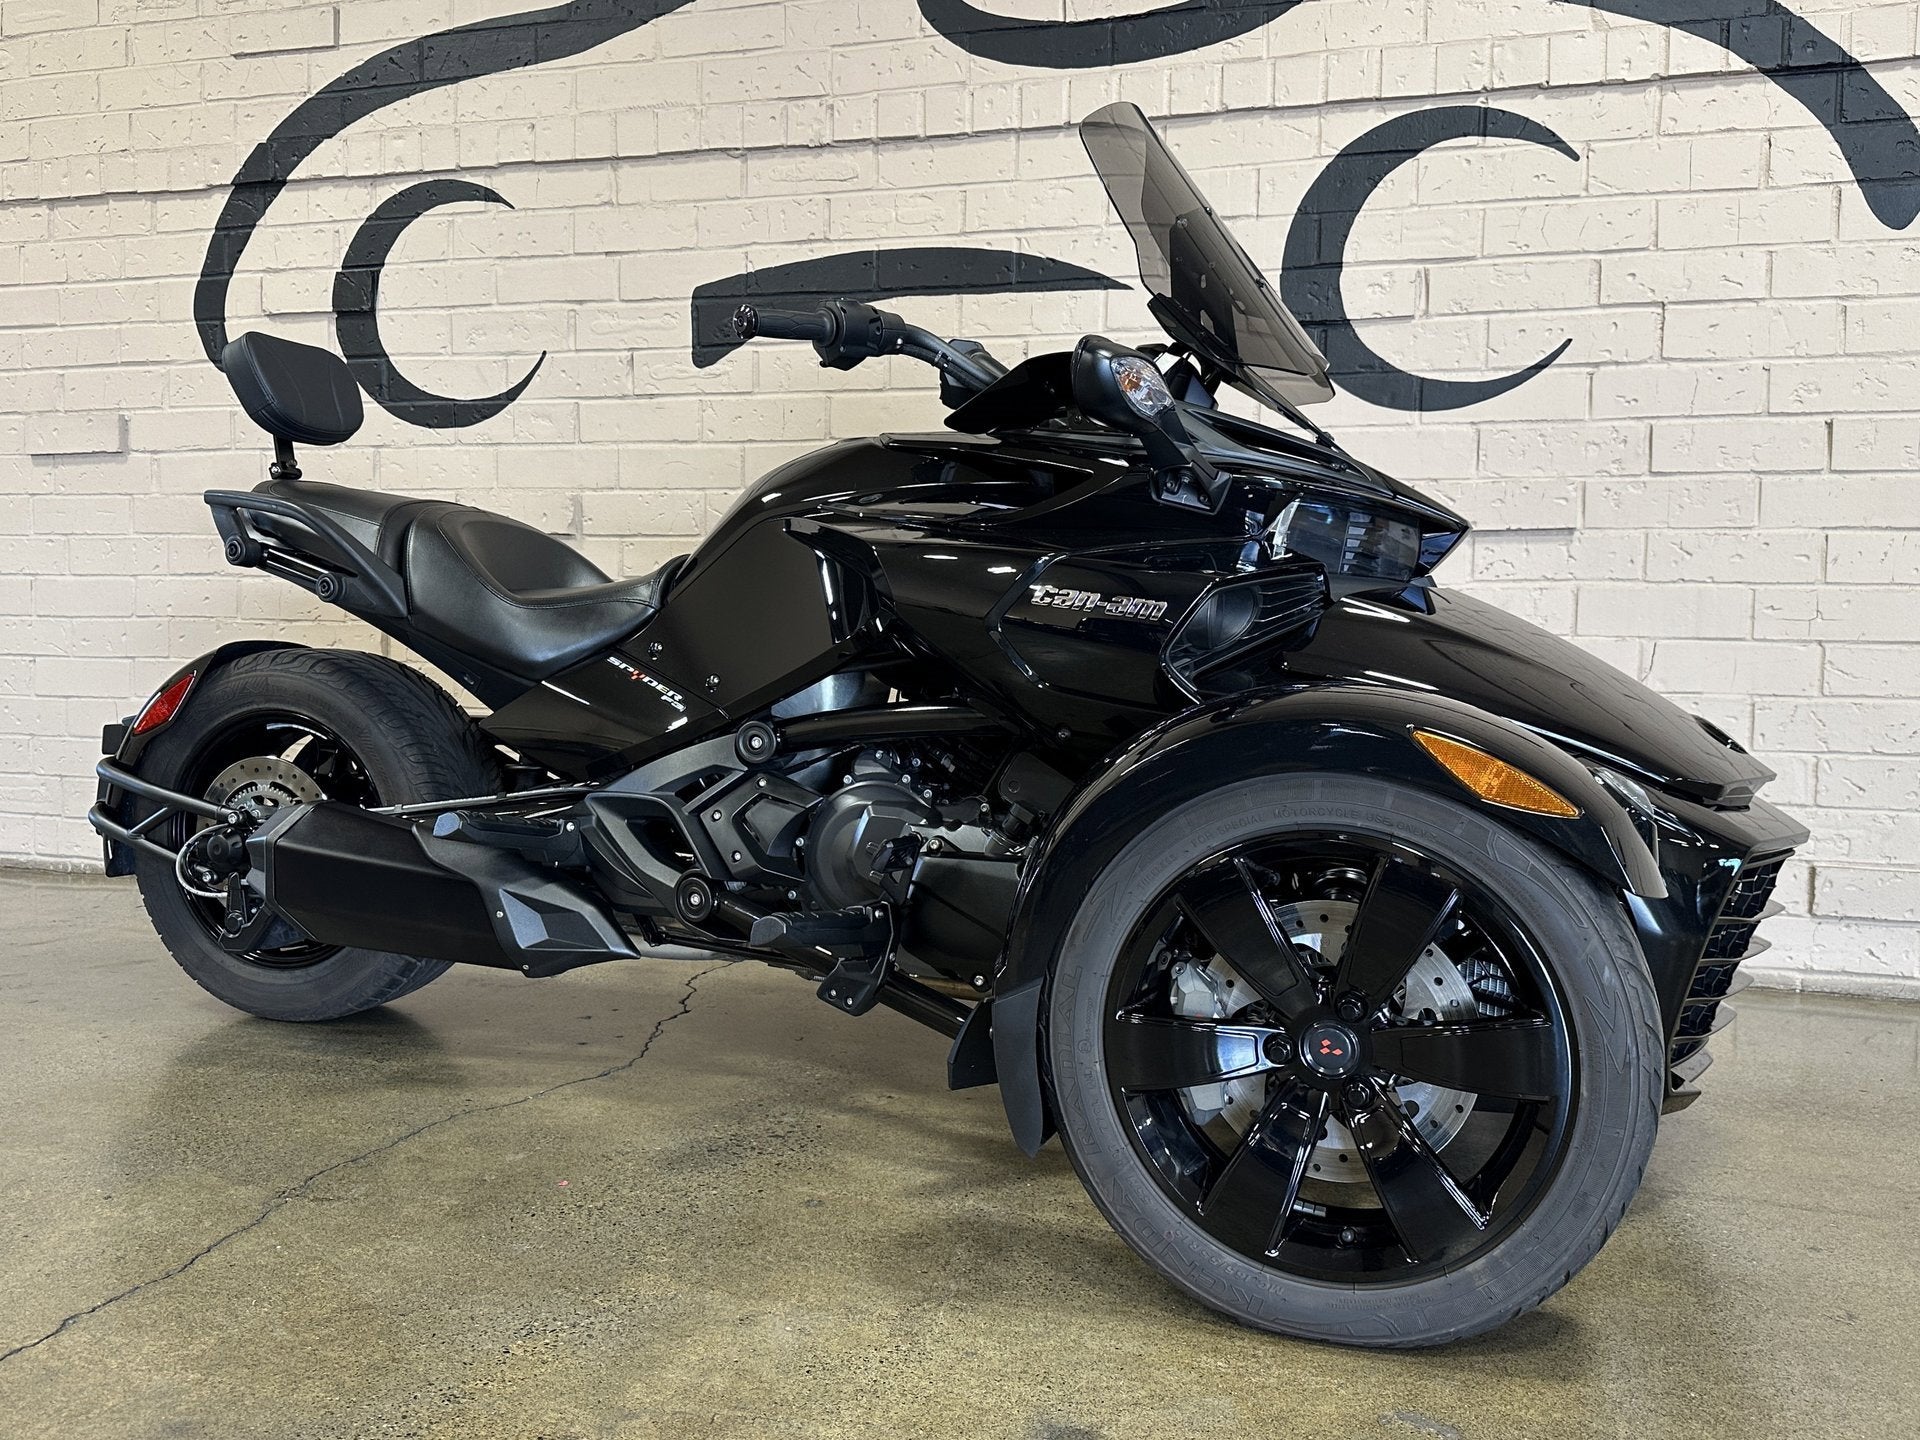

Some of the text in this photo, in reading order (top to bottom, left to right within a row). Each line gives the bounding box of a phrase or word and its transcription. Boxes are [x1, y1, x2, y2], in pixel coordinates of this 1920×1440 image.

[1030, 584, 1168, 621] can-am
[607, 656, 683, 701] SPYDER
[1272, 806, 1360, 820] MOTORCYCLE
[1056, 965, 1098, 1155] RADIAL
[1109, 1176, 1265, 1315] KENDA
